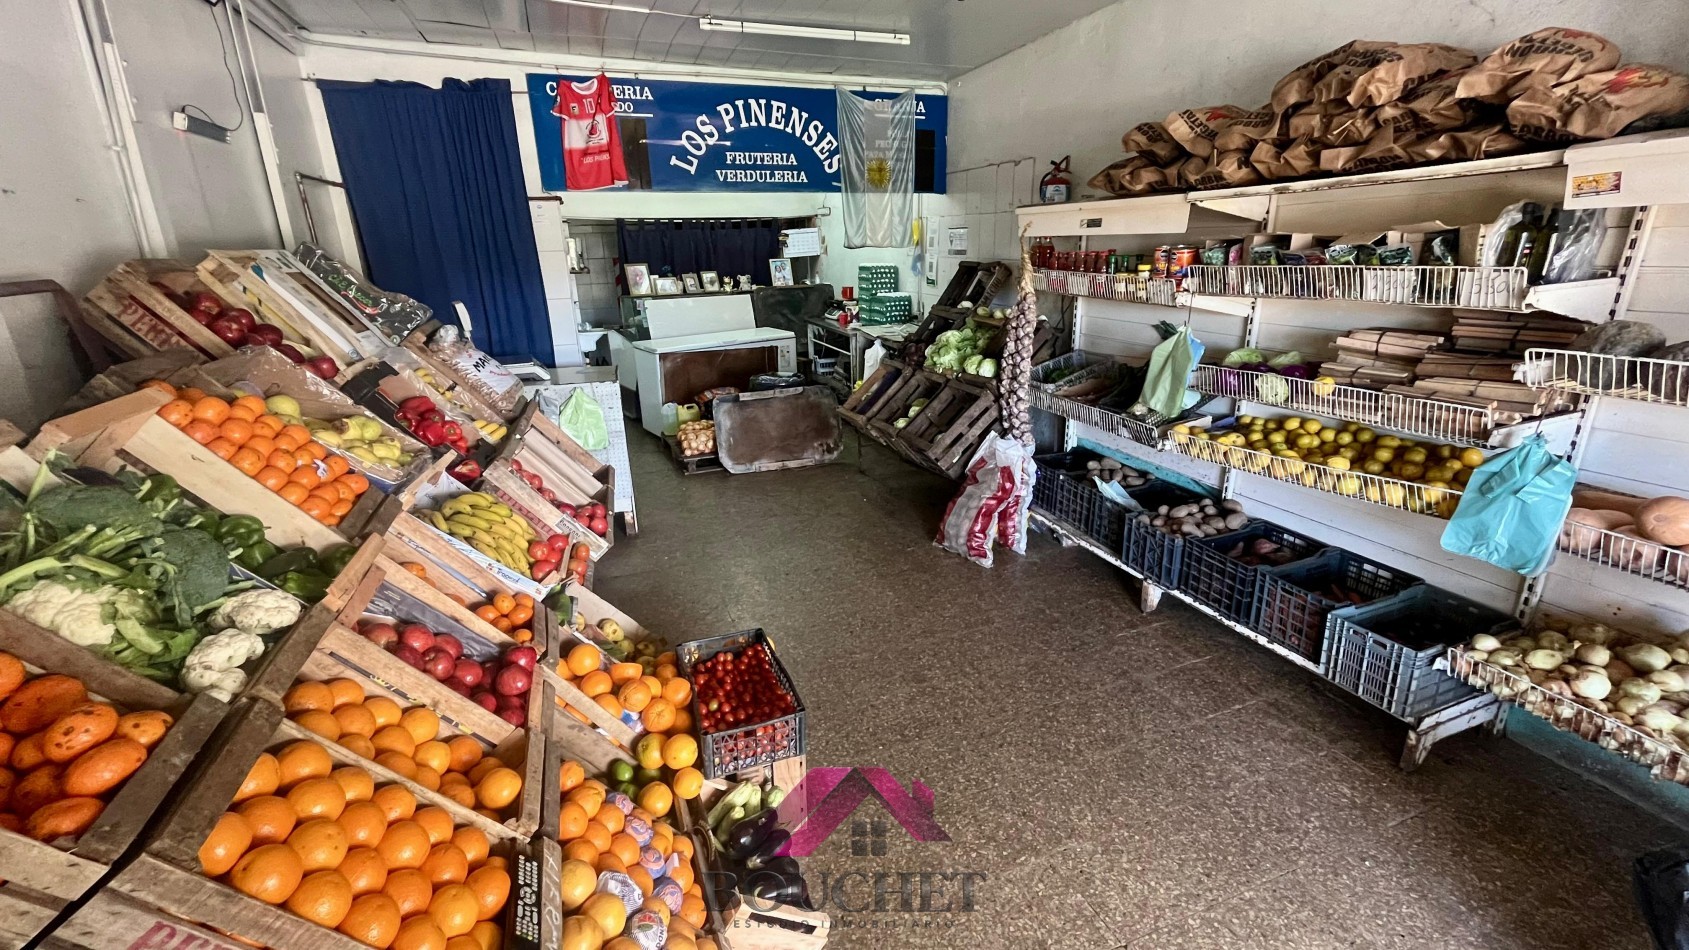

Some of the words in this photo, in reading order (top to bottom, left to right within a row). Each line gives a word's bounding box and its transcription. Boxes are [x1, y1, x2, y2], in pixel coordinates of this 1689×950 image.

[582, 98, 596, 114] 10
[669, 113, 719, 176] LOS
[716, 98, 842, 174] PINENSES
[725, 152, 798, 166] FRUTERIA
[715, 169, 809, 183] VERDULERIA
